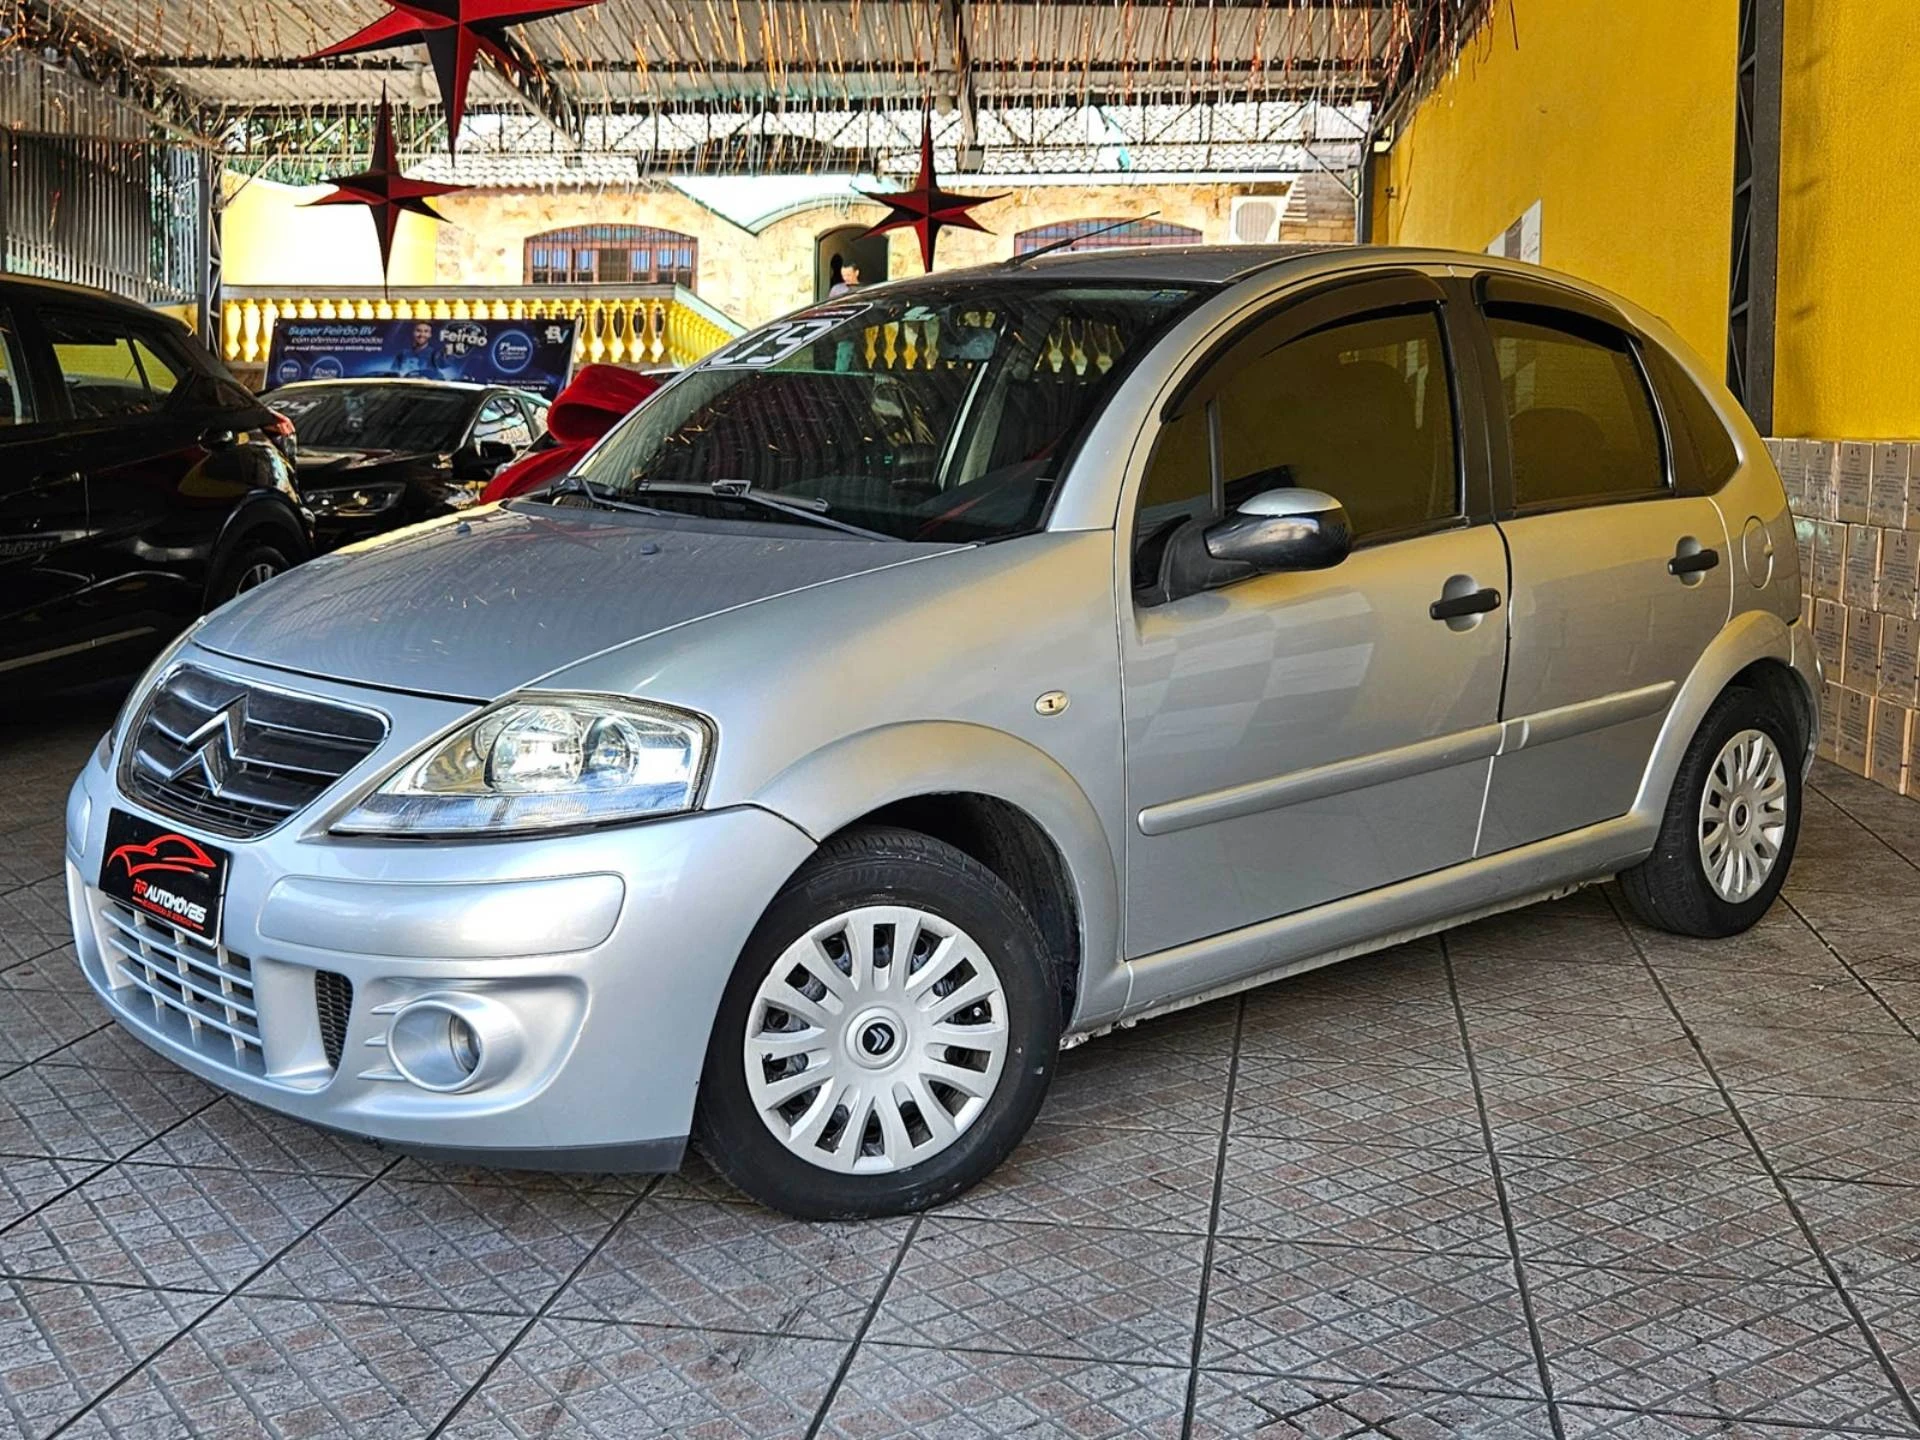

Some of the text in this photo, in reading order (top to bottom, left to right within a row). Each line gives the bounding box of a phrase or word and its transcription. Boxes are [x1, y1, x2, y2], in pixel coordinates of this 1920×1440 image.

[288, 325, 376, 337] Super Feirão BV
[440, 327, 488, 347] Feirão
[545, 325, 569, 344] BV
